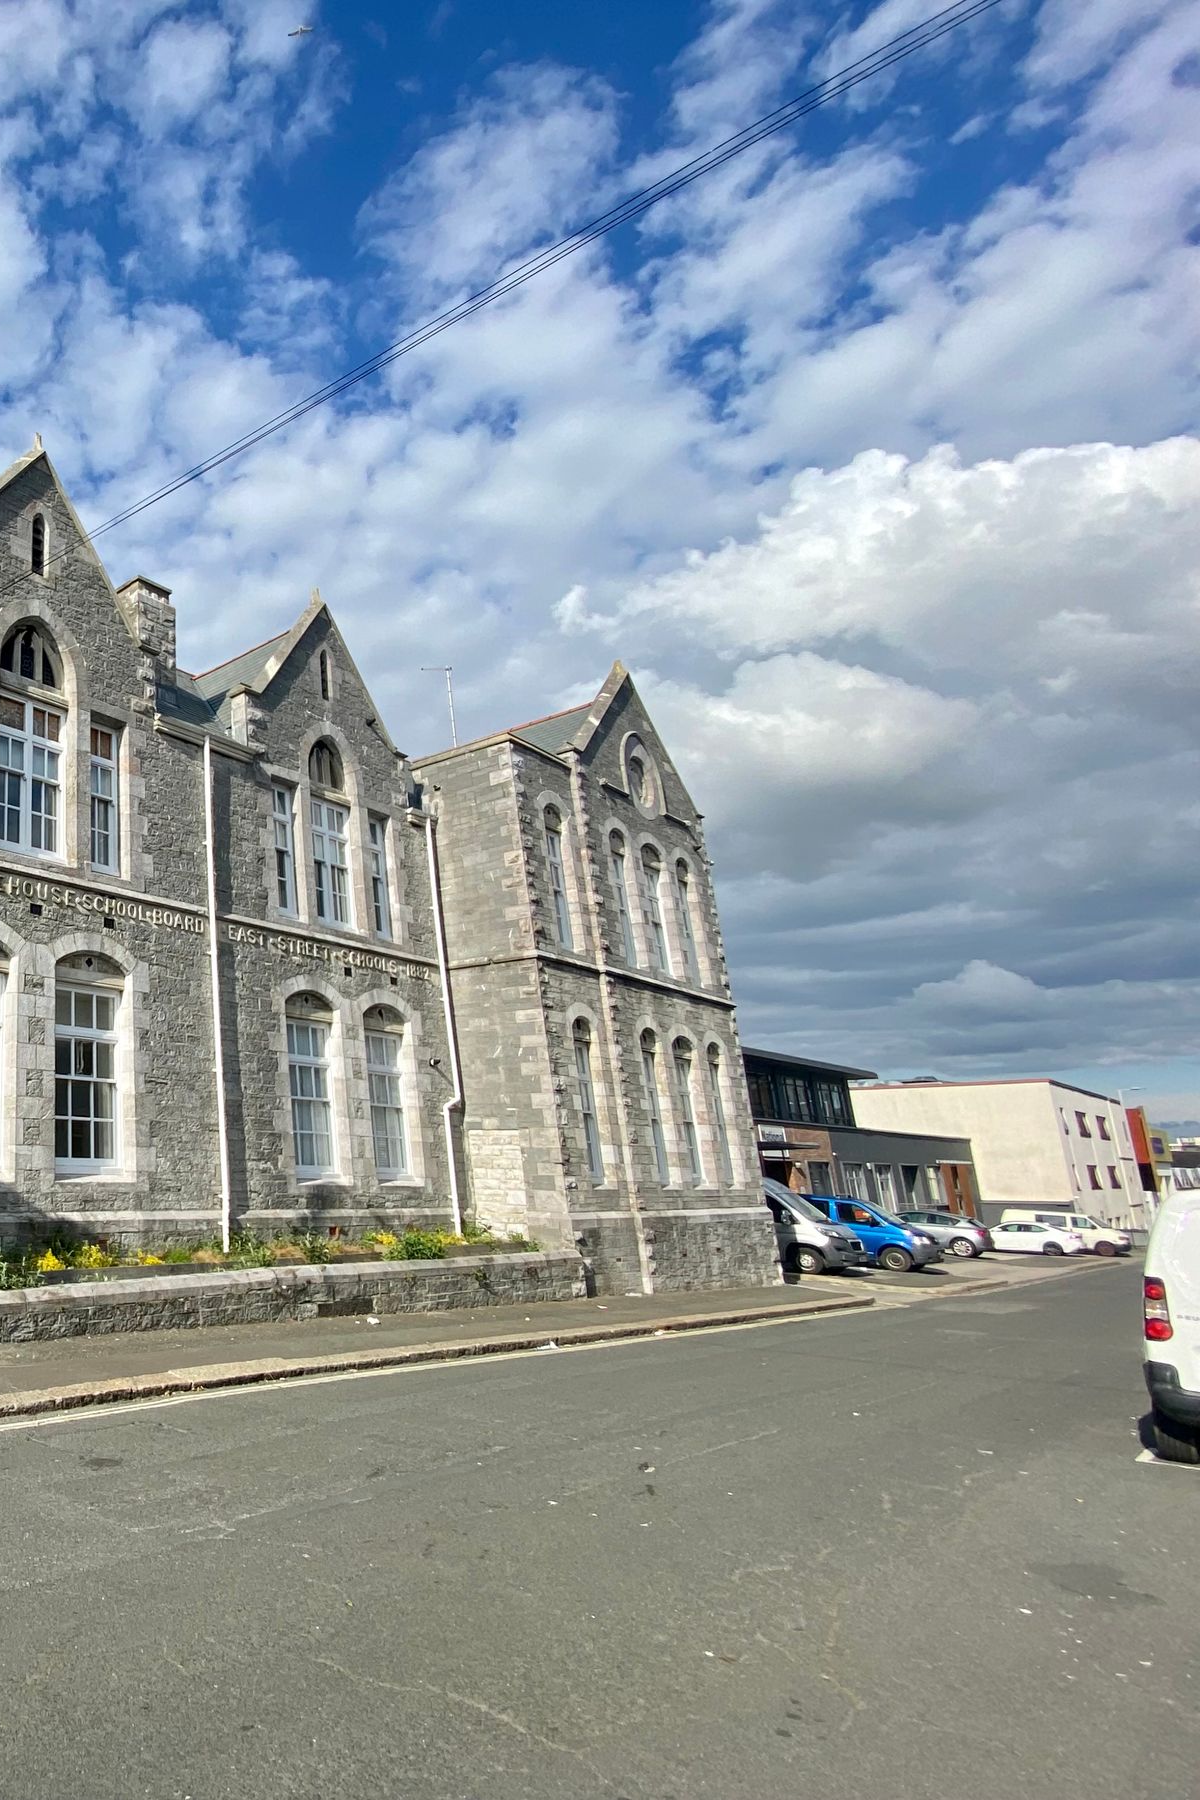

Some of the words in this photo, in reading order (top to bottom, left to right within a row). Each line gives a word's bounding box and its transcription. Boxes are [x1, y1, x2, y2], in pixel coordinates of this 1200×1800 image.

[83, 893, 147, 921] SCHOOL
[152, 908, 205, 933] BOARD
[228, 925, 266, 946] EAST
[277, 936, 330, 960] STREET
[341, 949, 397, 973] SCHOOLS
[406, 963, 431, 980] 1882
